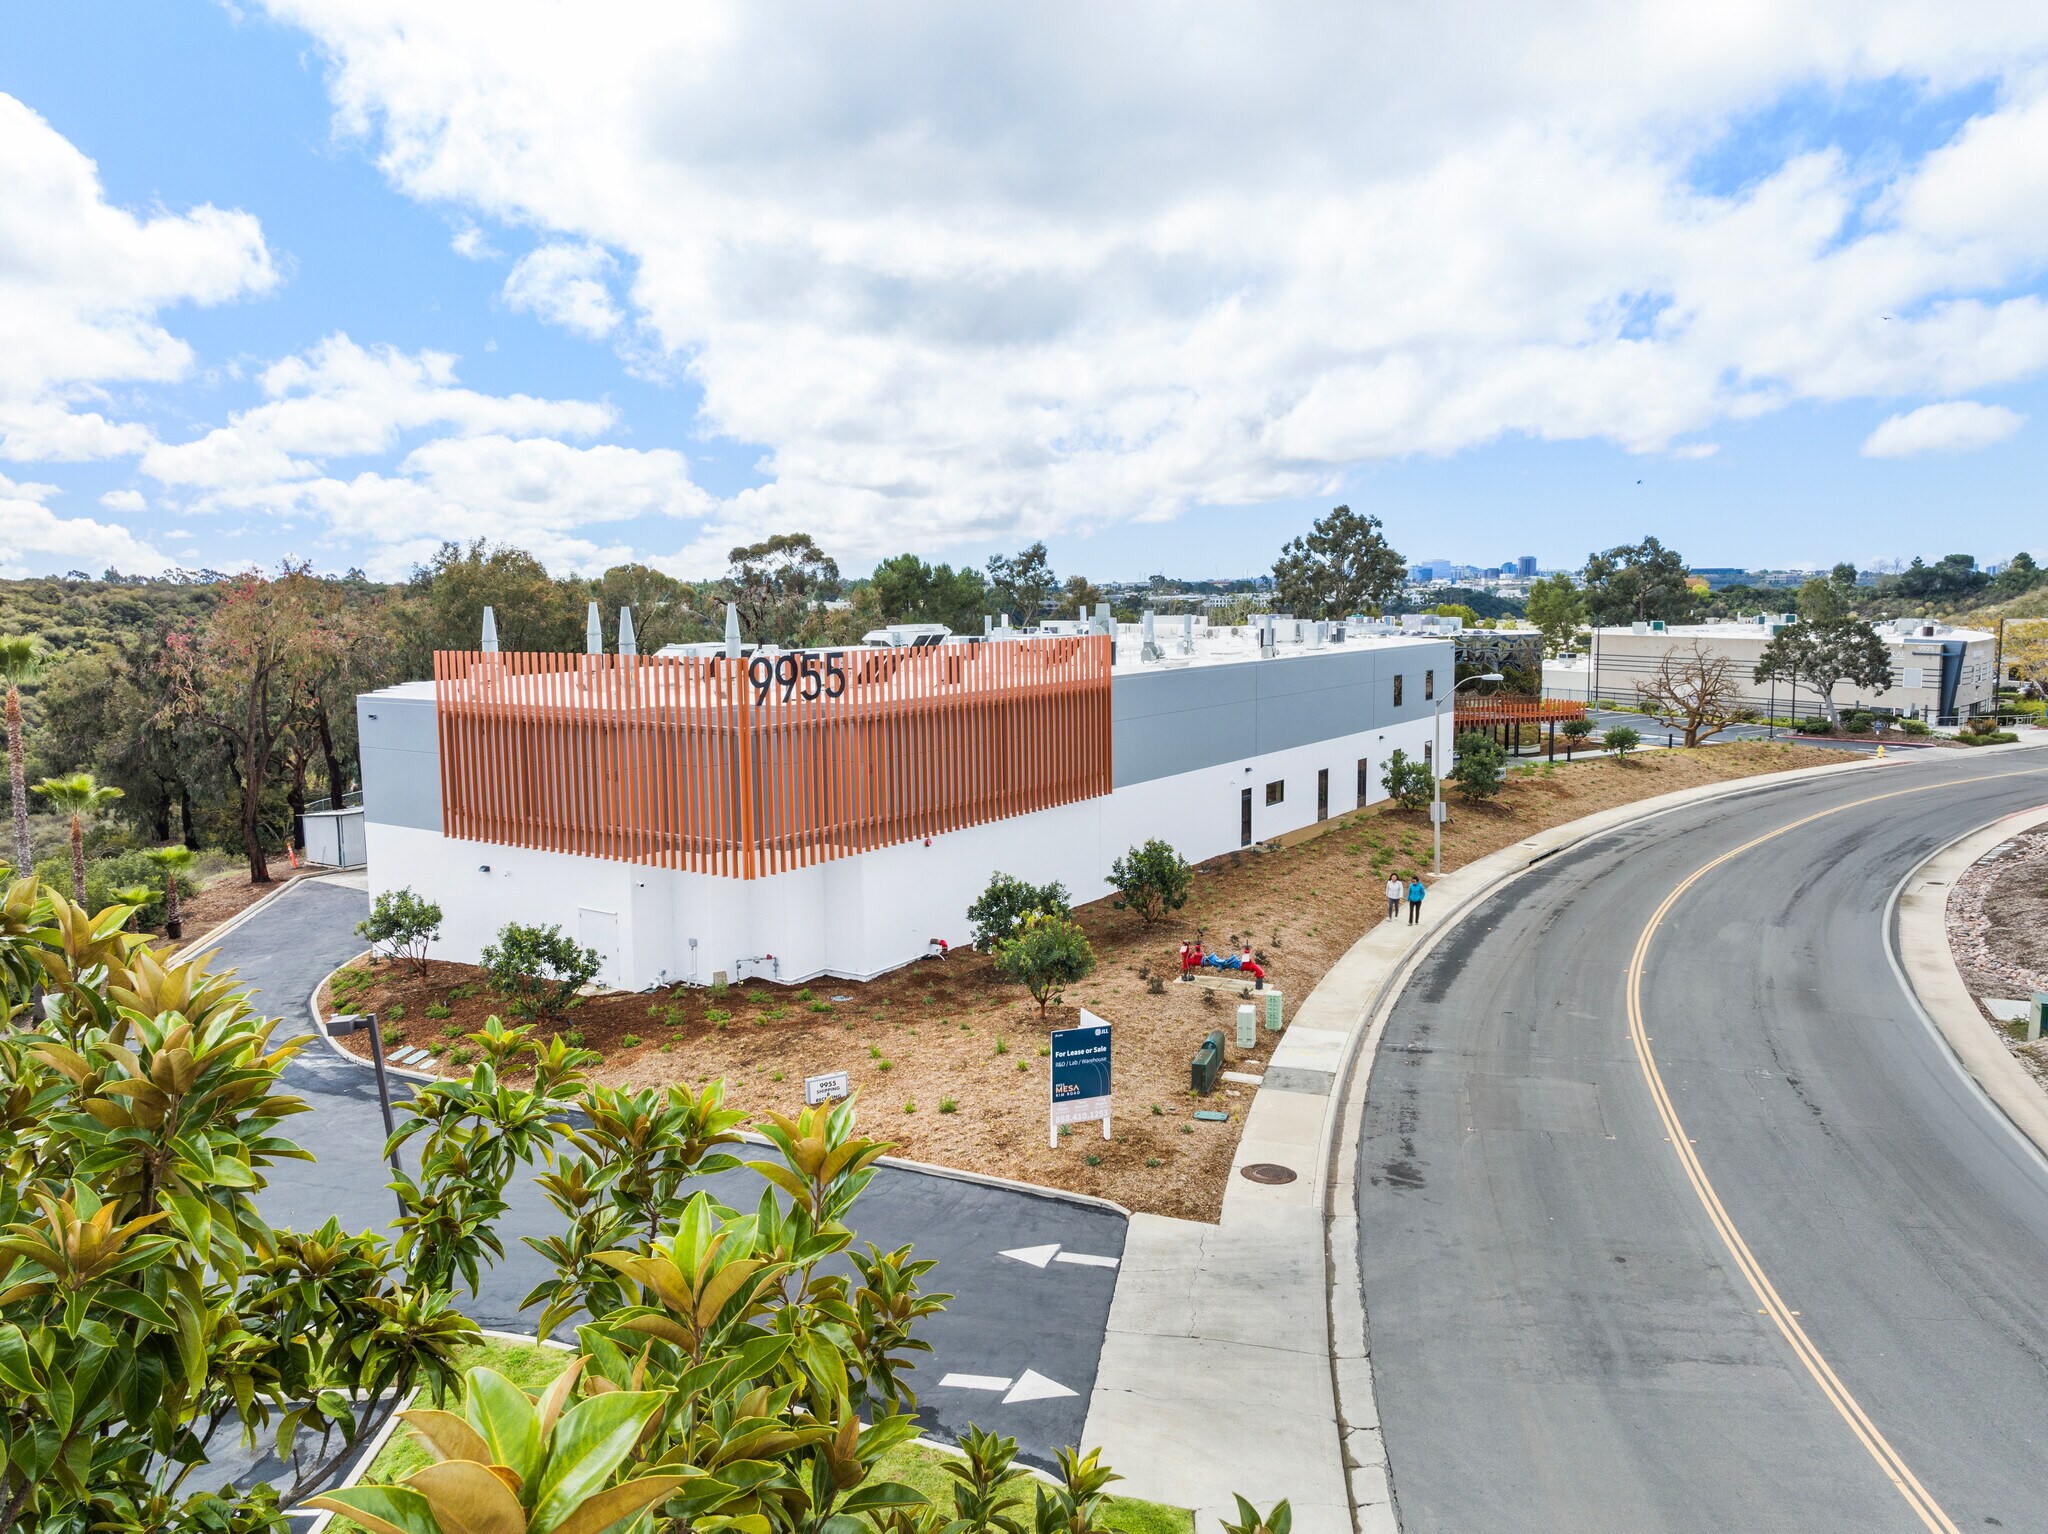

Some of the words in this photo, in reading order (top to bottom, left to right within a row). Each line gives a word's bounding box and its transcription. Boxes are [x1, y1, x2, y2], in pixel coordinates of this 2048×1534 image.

[748, 653, 846, 706] 9955
[1066, 1049, 1085, 1057] Lease
[1093, 1045, 1107, 1053] Sale
[820, 1080, 836, 1088] 9955
[1055, 1084, 1080, 1093] MESA
[816, 1086, 841, 1094] SHIPPING
[816, 1094, 841, 1102] RECING
[1055, 1110, 1109, 1123] 858.410.1253
